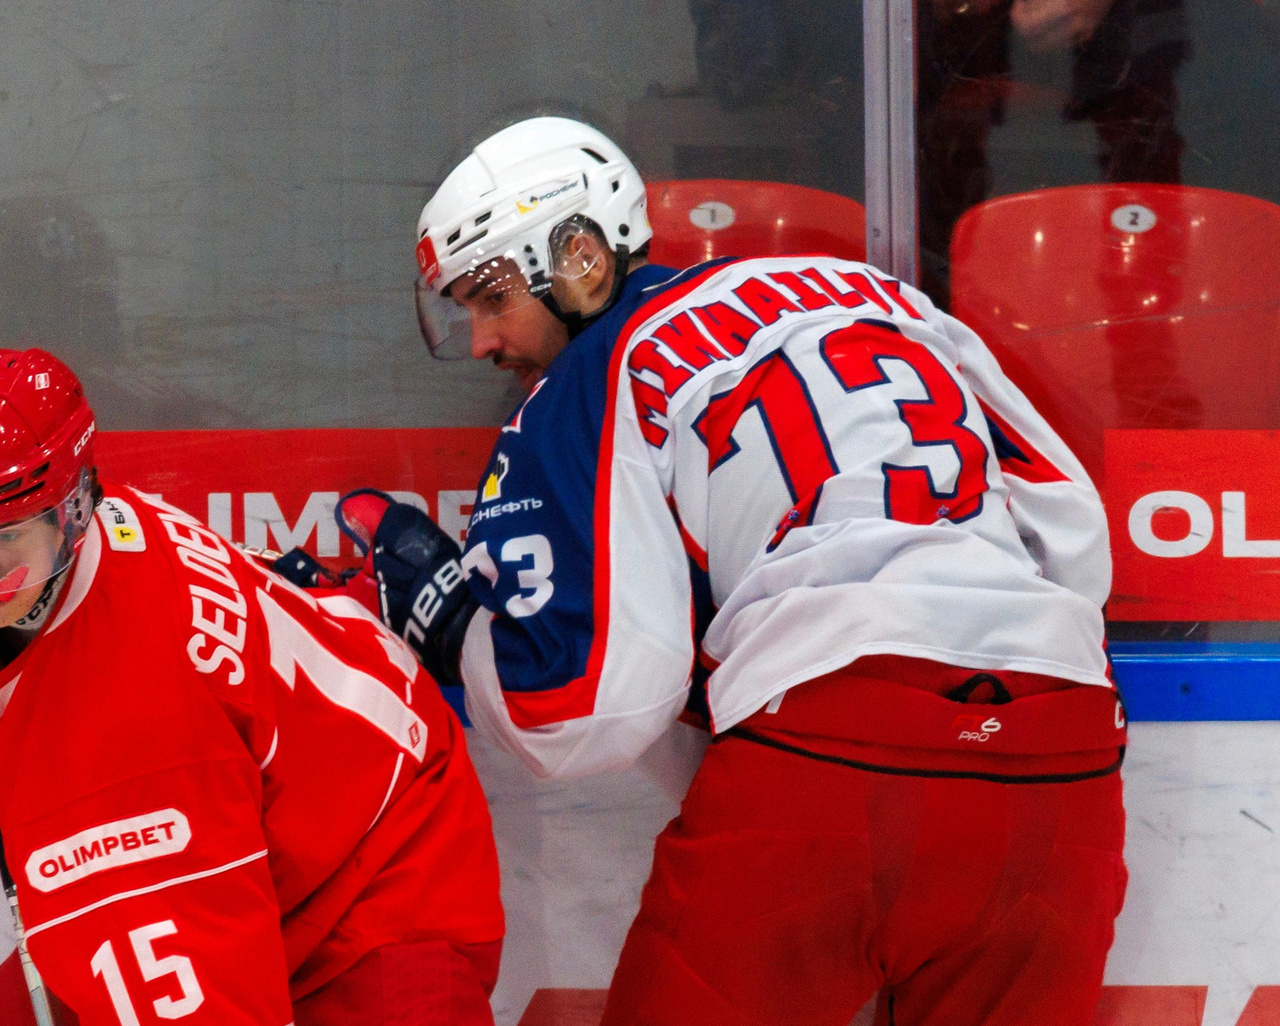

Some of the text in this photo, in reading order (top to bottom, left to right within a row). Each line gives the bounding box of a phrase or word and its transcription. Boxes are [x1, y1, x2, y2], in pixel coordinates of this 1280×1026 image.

[1129, 211, 1139, 226] 2
[529, 281, 553, 294] CCM
[73, 420, 96, 457] CCM
[690, 318, 990, 554] 73
[467, 497, 543, 536] СНЕФТЬ
[953, 712, 1002, 733] FT6
[958, 730, 990, 743] PRO
[38, 820, 178, 879] OLIMPBET
